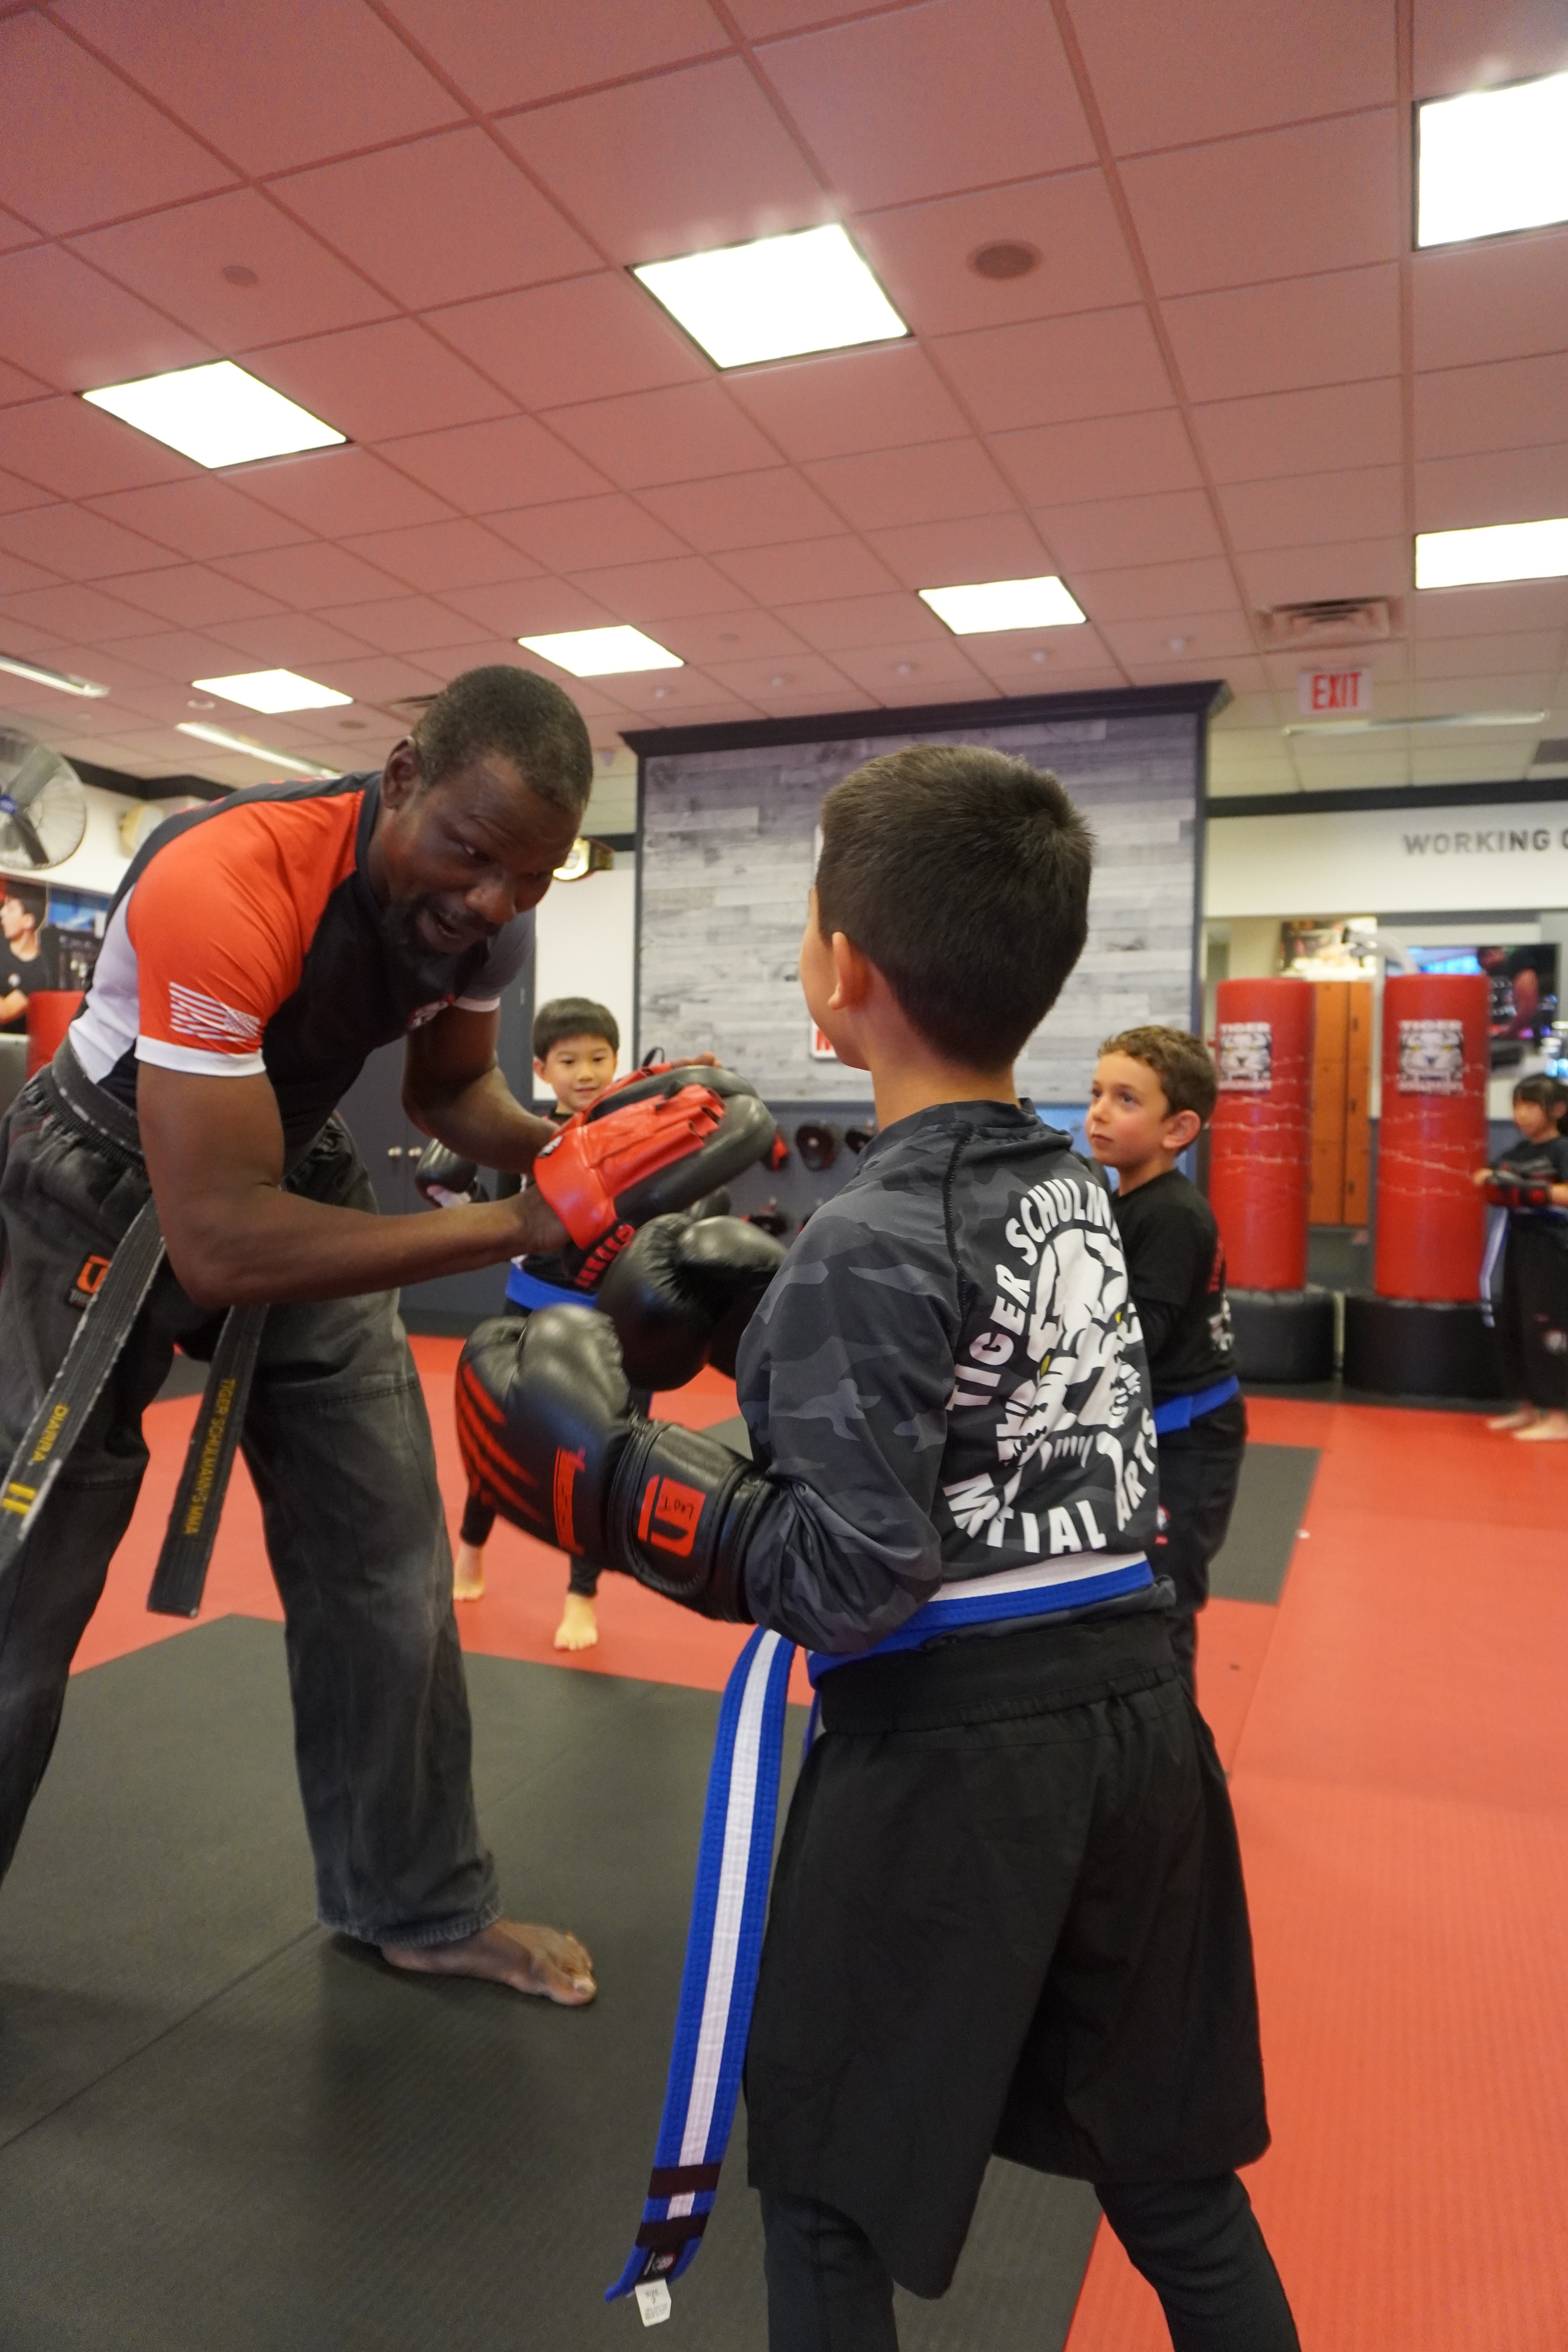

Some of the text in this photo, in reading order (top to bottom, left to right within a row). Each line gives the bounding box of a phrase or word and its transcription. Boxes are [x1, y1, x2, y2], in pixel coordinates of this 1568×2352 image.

[1312, 671, 1362, 710] EXIT
[1403, 829, 1551, 855] WORKING
[945, 1263, 1033, 1410] TIGER
[1116, 1407, 1158, 1532] ARTS
